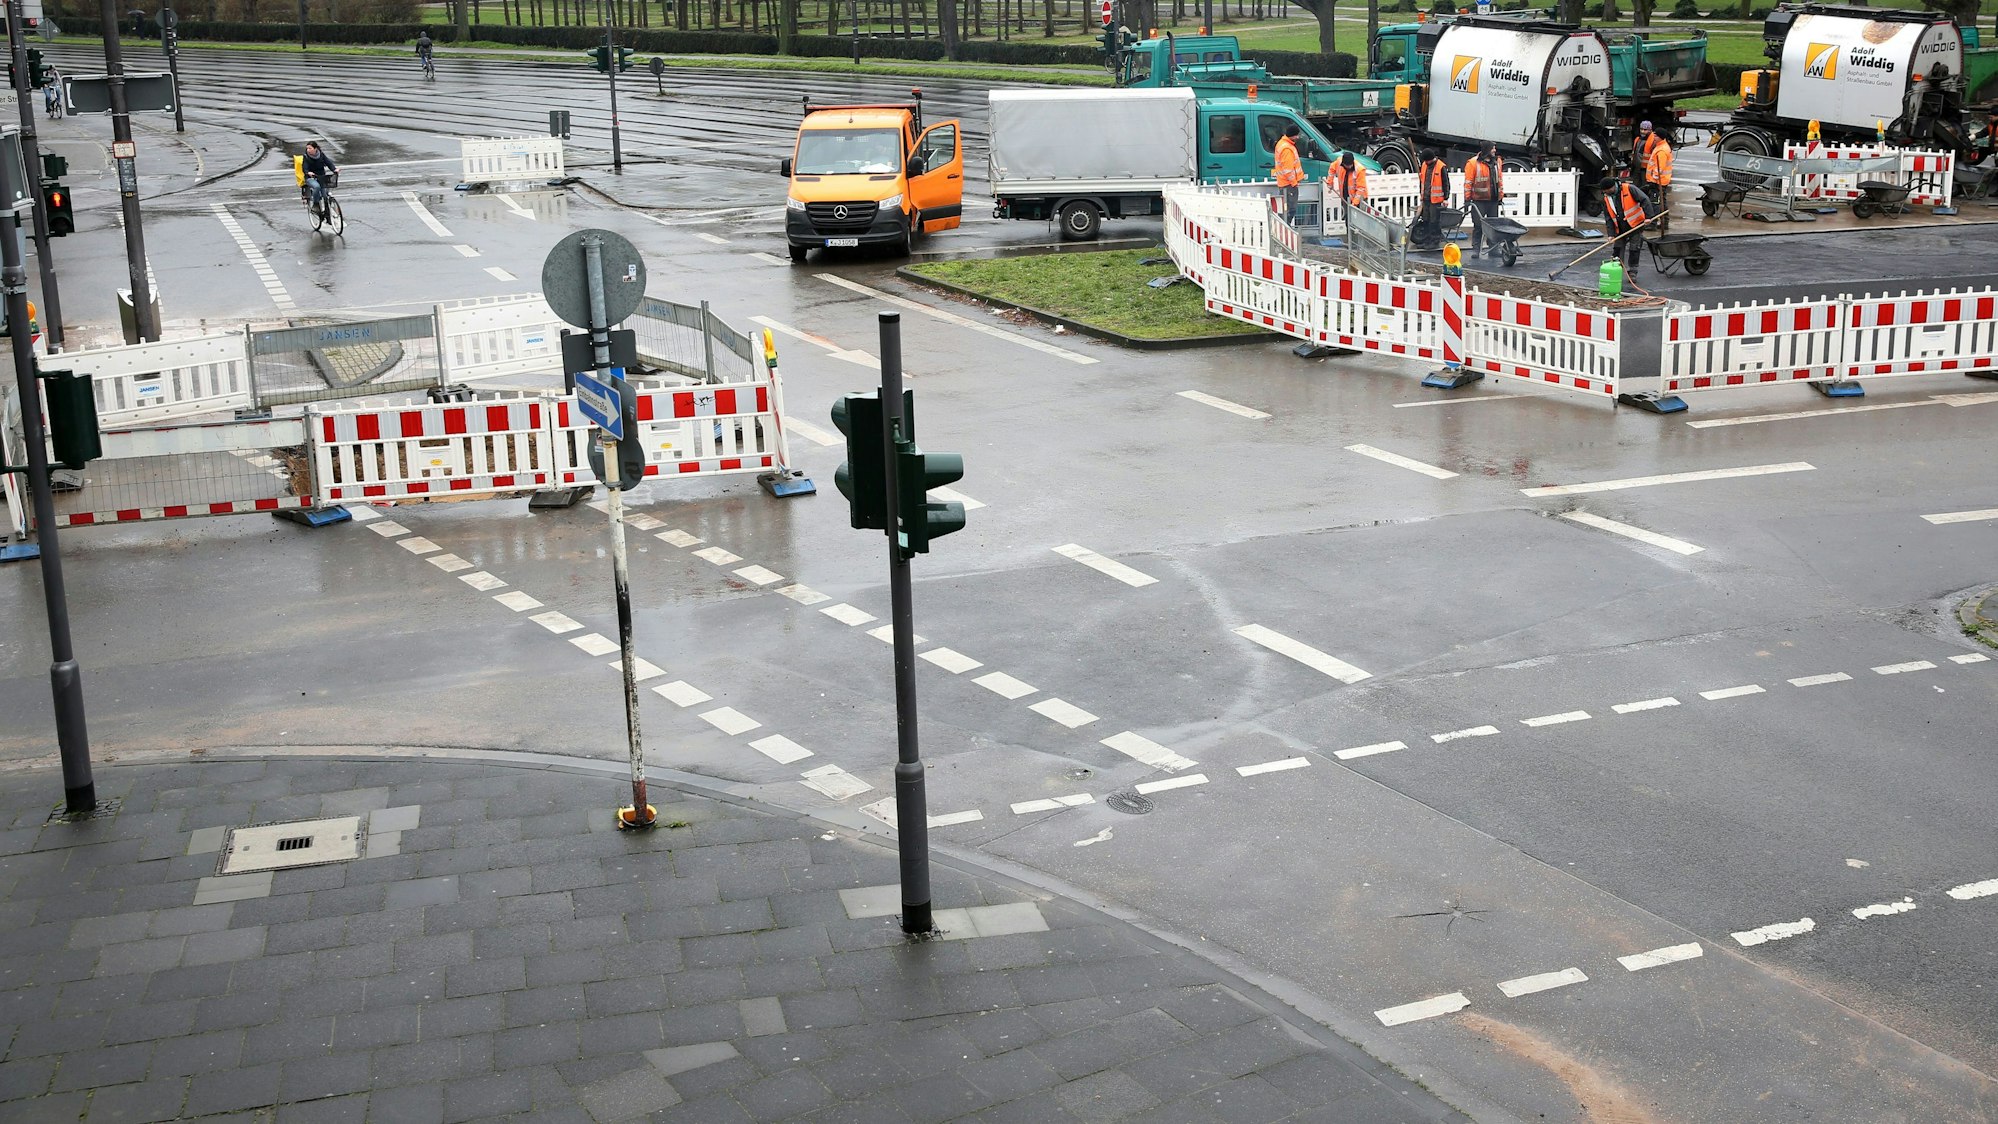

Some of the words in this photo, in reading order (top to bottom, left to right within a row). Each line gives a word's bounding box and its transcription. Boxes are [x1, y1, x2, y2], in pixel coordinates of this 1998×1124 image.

[1851, 46, 1875, 55] Adolf
[1920, 42, 1956, 54] WIDDIG
[1491, 59, 1513, 68] Adolf
[1556, 54, 1601, 67] WIDDIG
[1850, 55, 1895, 73] Widdig
[1490, 68, 1530, 86] Widdig
[1847, 70, 1867, 79] Asphalt-
[1876, 79, 1893, 87] GmbH
[1366, 93, 1374, 104] A
[318, 328, 371, 341] JANSEN
[139, 385, 160, 393] JANSEN
